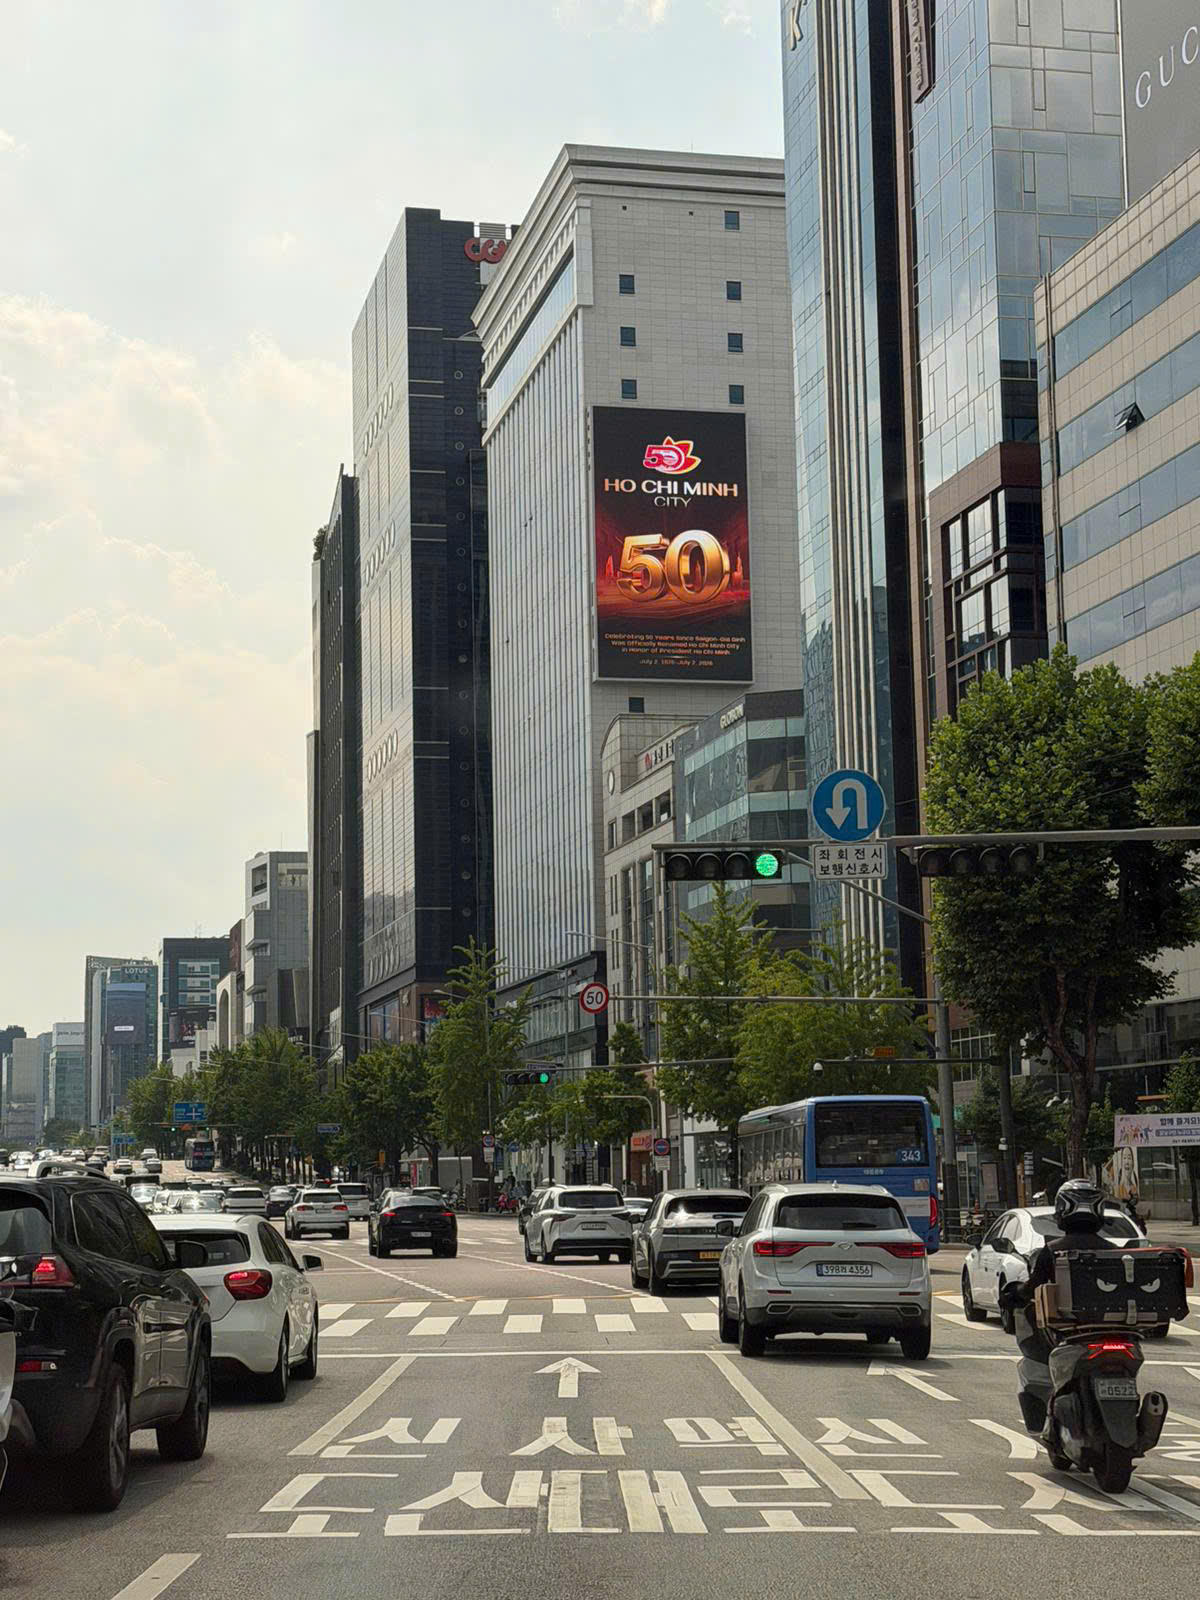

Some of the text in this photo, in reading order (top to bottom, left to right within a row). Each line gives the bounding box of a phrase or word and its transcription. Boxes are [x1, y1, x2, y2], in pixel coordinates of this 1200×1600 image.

[464, 238, 507, 264] CG
[604, 478, 738, 497] HO CHI MINH
[654, 496, 692, 508] CITY
[616, 529, 731, 604] 50
[604, 633, 645, 641] Celebrating
[819, 861, 883, 875] 보행신호시
[586, 991, 604, 1005] 50
[901, 1150, 921, 1161] 343
[319, 1416, 789, 1458] 신사역
[226, 1468, 858, 1540] 도산대로
